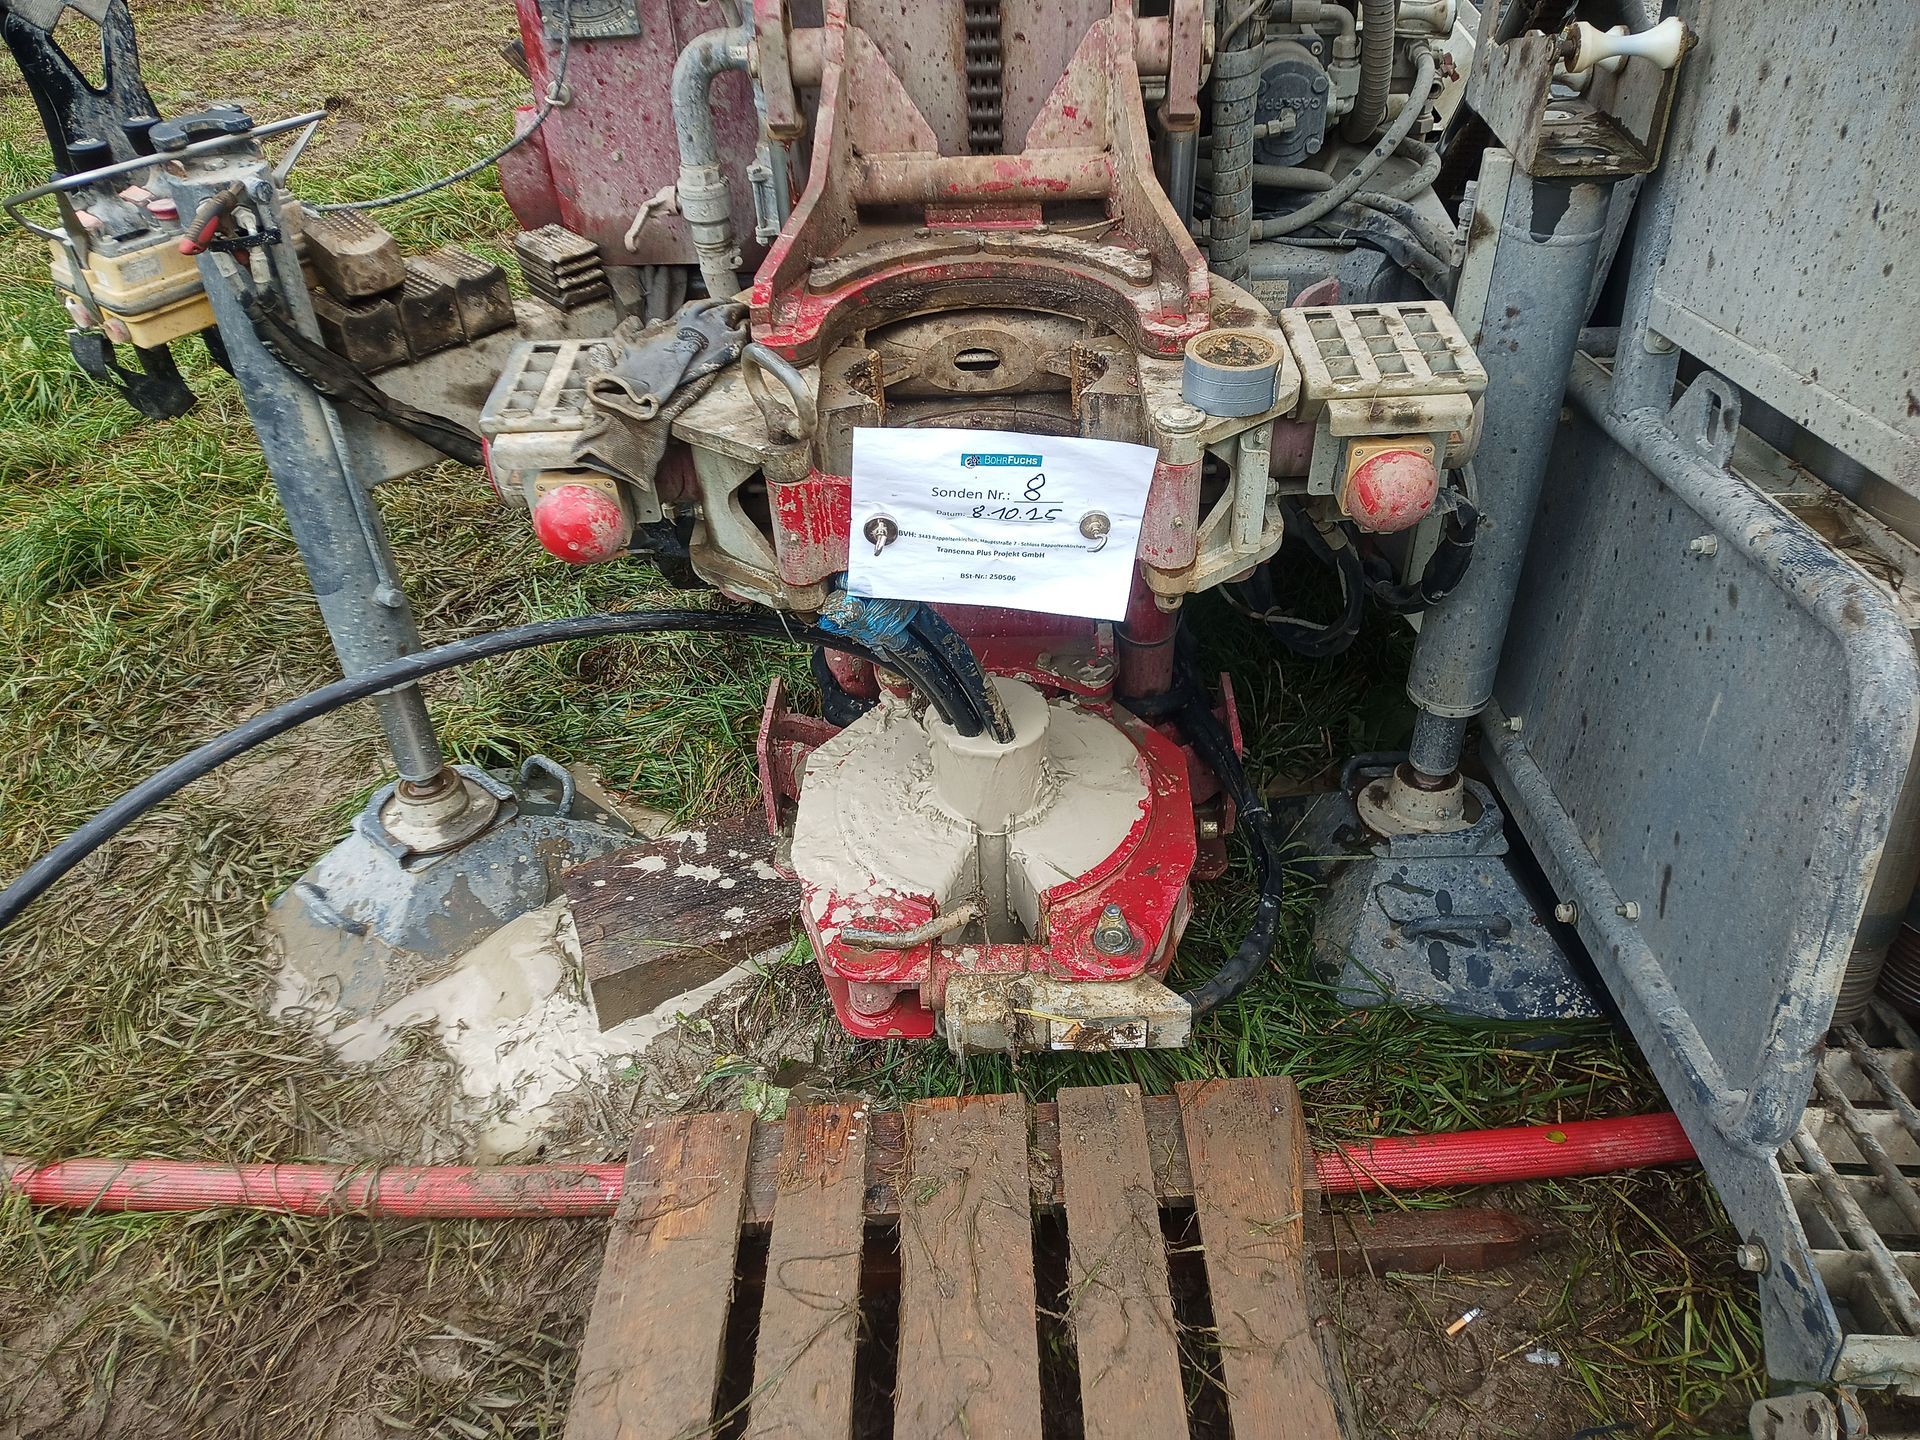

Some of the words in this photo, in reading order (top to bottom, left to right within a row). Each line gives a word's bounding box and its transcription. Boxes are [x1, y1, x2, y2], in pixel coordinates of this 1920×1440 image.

[931, 486, 983, 500] Sonden
[987, 488, 1010, 501] Nr.:
[1024, 473, 1046, 501] 8
[936, 509, 966, 518] Datum:
[898, 530, 917, 538] BVH:
[937, 546, 974, 556] Transenna
